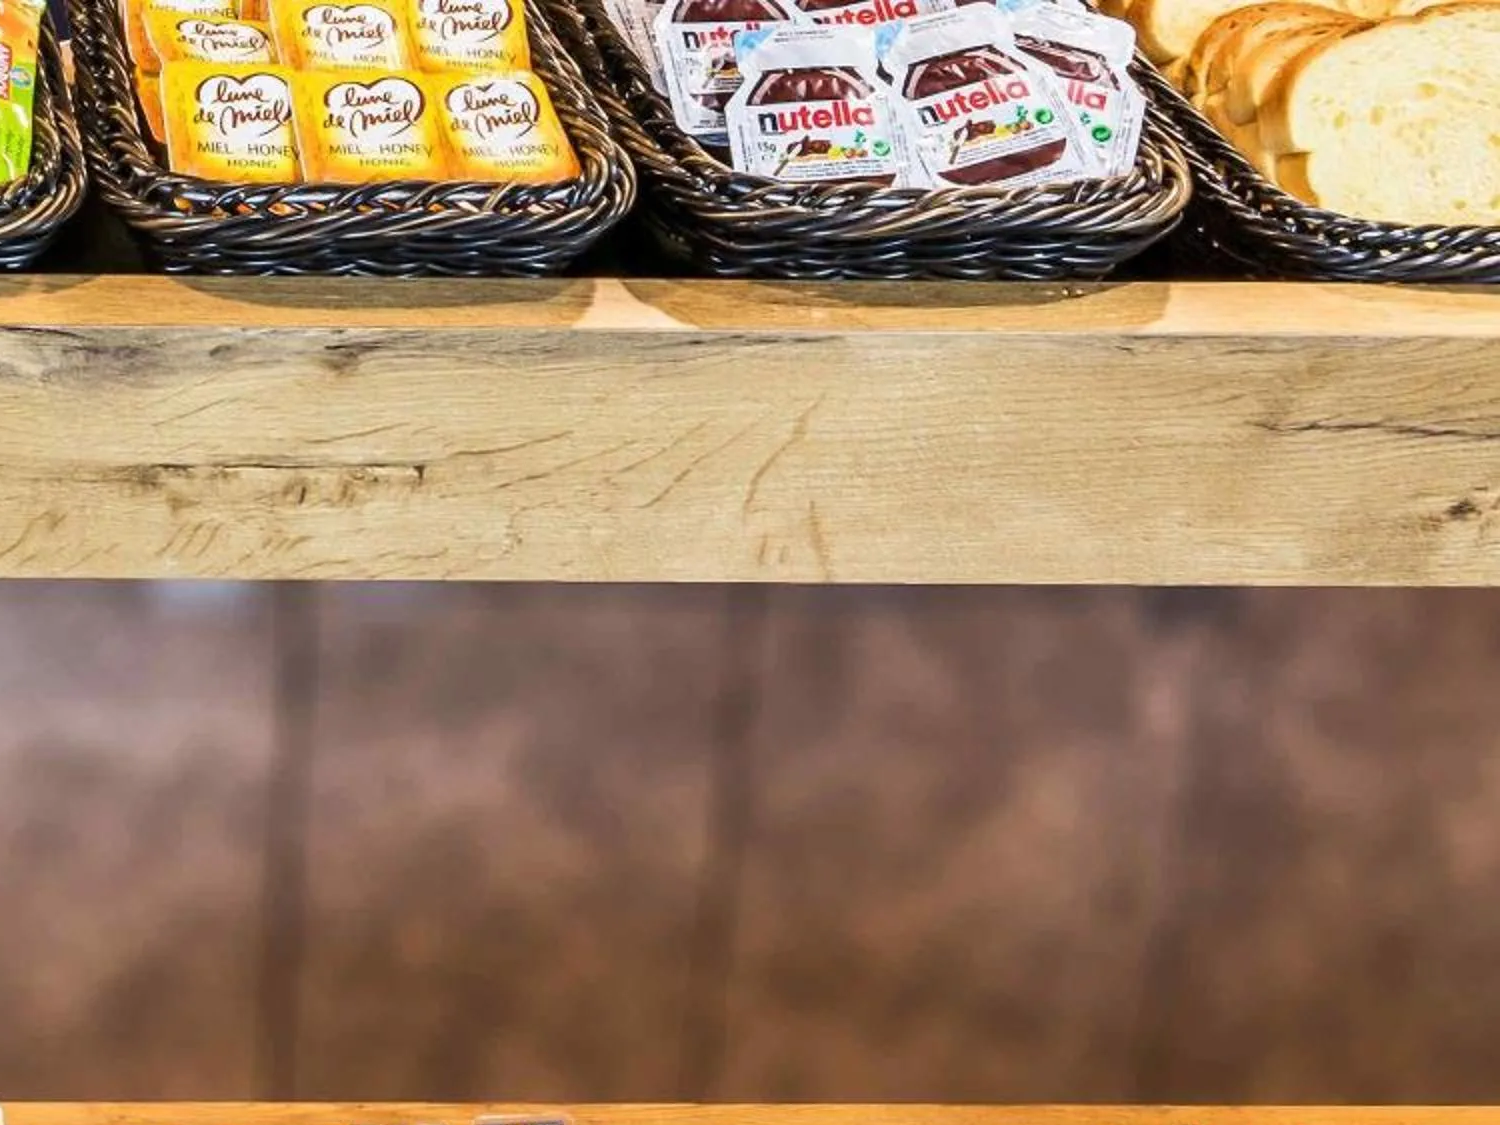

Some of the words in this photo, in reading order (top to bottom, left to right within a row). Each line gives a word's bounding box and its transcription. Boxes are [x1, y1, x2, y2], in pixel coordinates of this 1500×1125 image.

[340, 87, 394, 108] lune
[917, 80, 1030, 126] nutella
[758, 102, 875, 132] nutella
[197, 142, 230, 155] MIEL
[248, 143, 299, 158] HONEY
[329, 144, 364, 155] MIEL
[379, 144, 433, 157] HONEY
